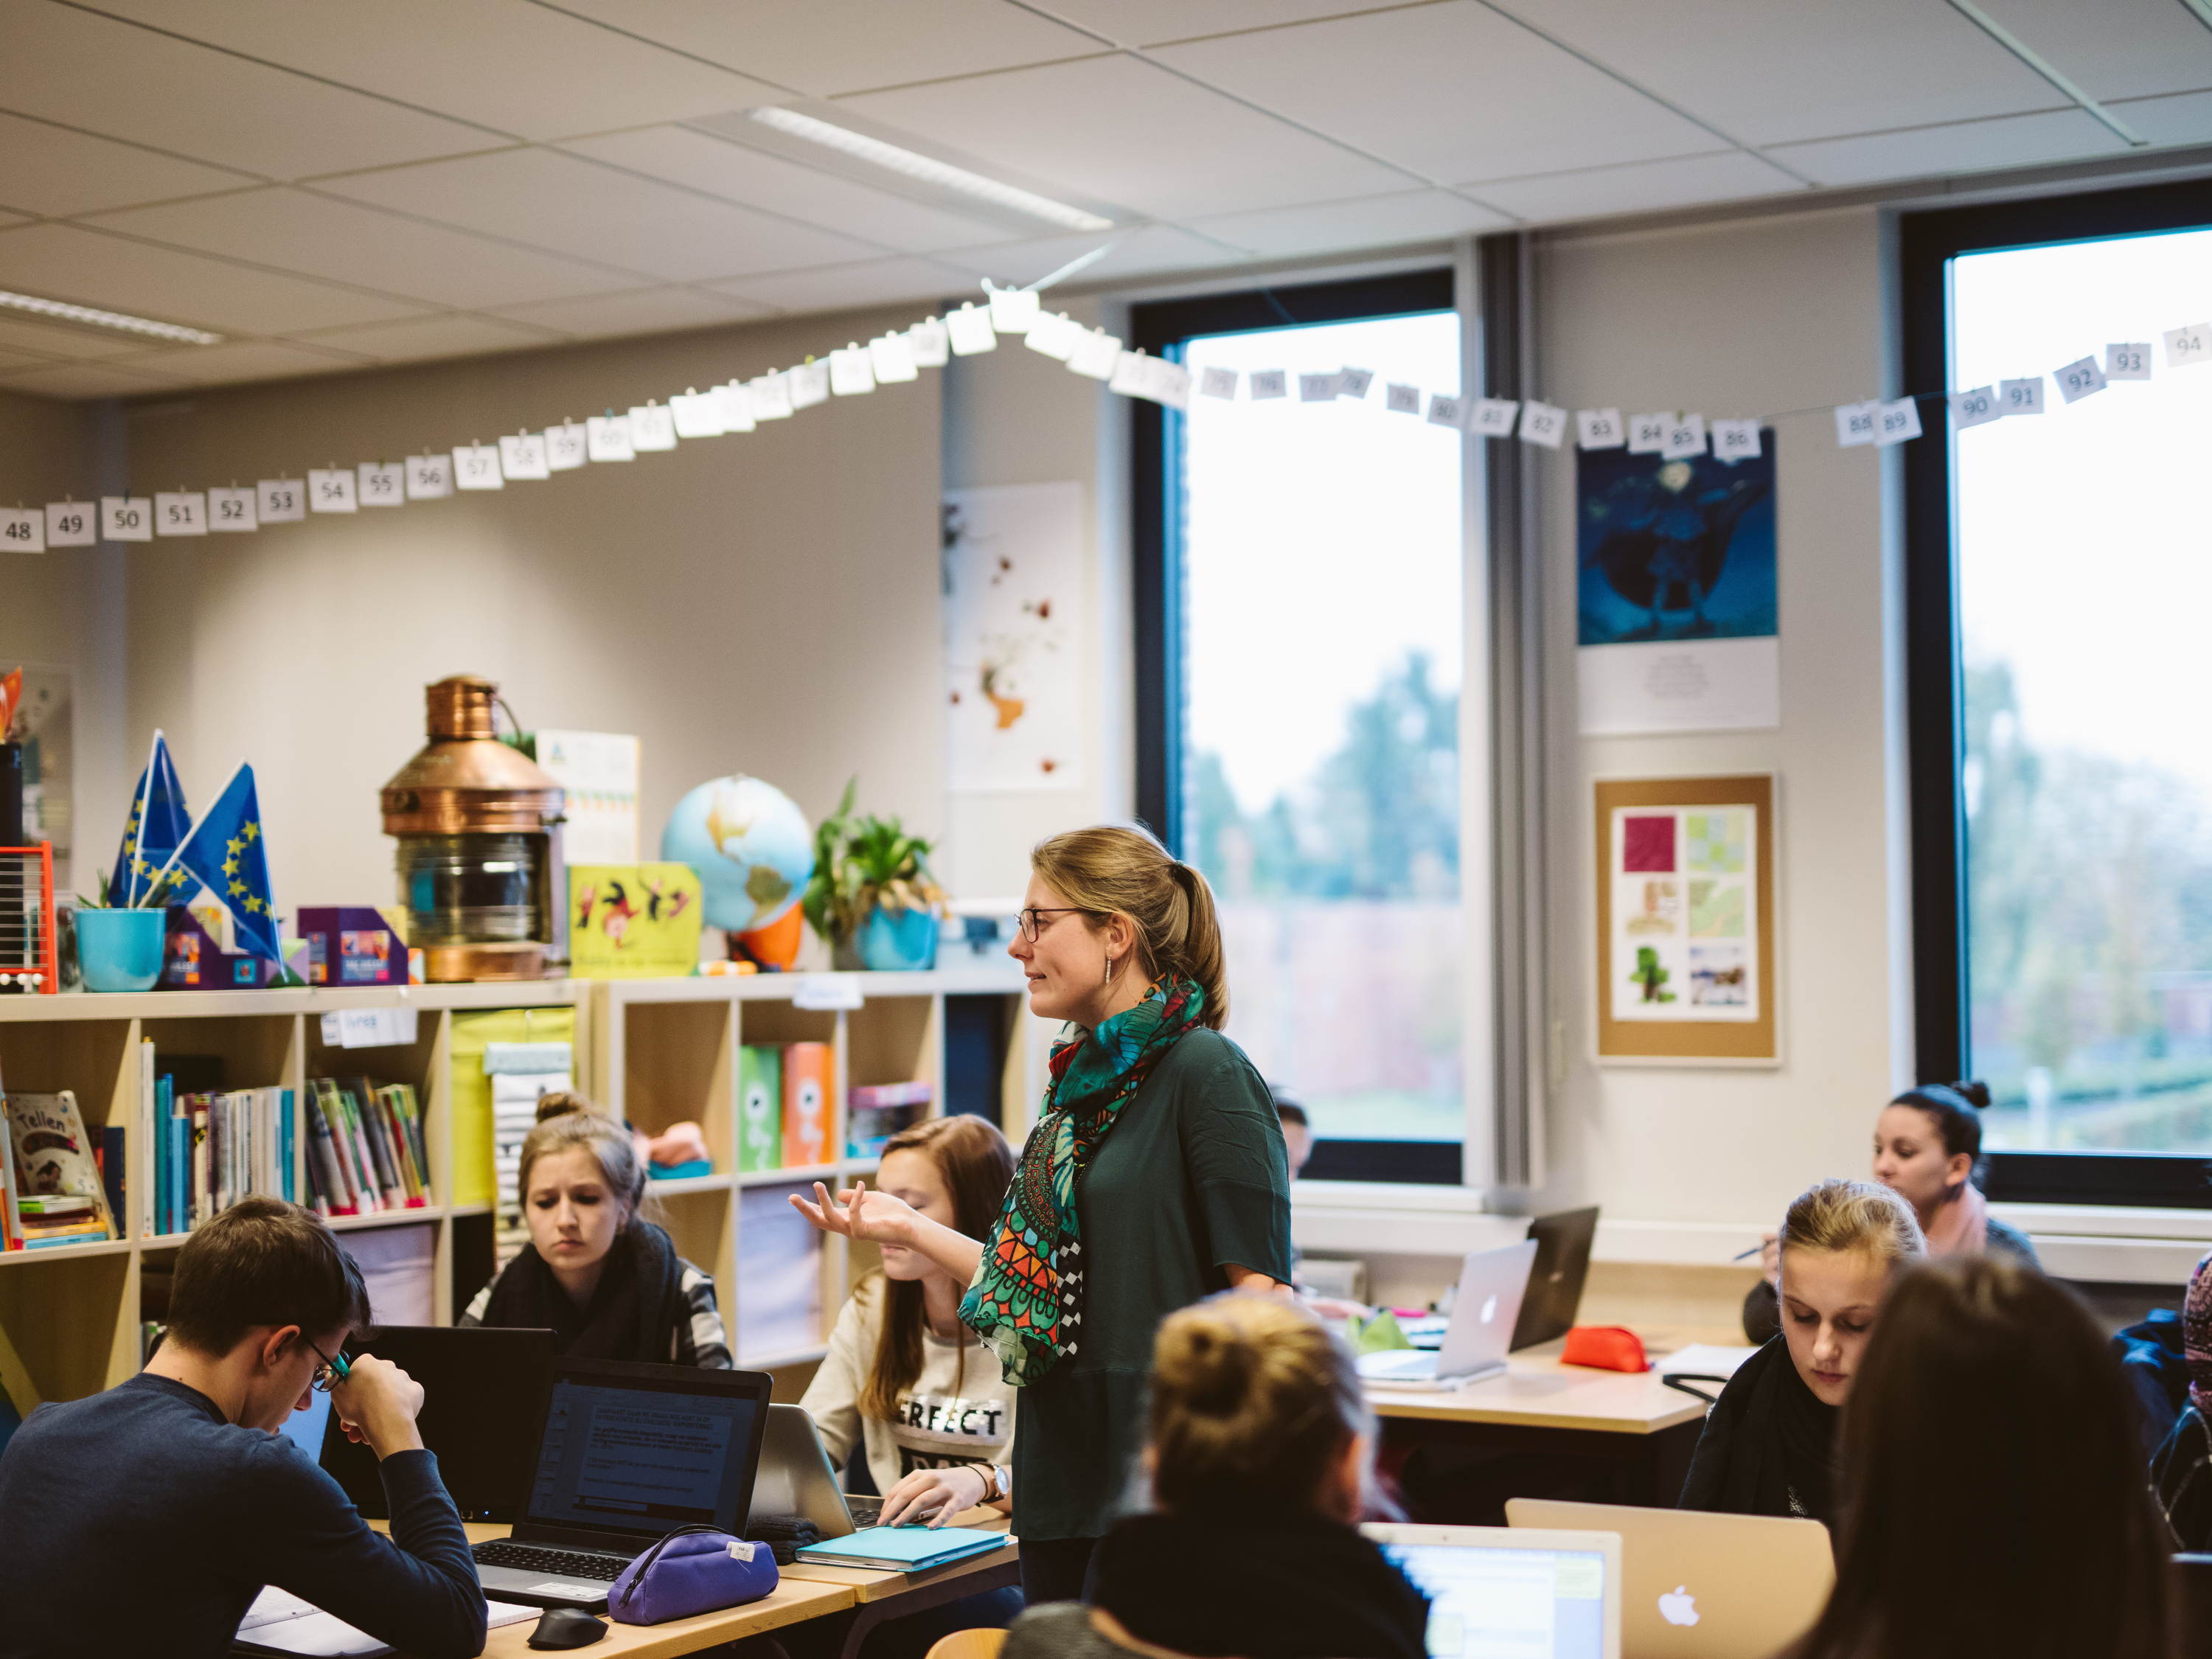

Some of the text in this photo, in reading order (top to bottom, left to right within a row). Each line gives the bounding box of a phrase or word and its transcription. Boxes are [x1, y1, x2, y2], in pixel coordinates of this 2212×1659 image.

[2177, 335, 2202, 357] 94
[2117, 352, 2141, 372] 93
[2068, 369, 2094, 392] 92
[2011, 388, 2034, 406] 91
[1964, 396, 1988, 418] 90
[1590, 419, 1613, 437] 83
[1849, 414, 1873, 433] 88
[1884, 411, 1907, 431] 89
[1641, 424, 1662, 441] 84
[1672, 426, 1694, 445] 85
[1725, 429, 1748, 446] 86
[418, 467, 441, 485] 56
[467, 459, 489, 478] 57
[321, 481, 344, 500] 54
[370, 475, 392, 494] 55
[221, 501, 244, 518] 52
[270, 492, 293, 510] 53
[114, 510, 139, 529] 50
[169, 505, 192, 524] 51
[6, 522, 30, 540] 48
[59, 515, 83, 534] 49
[16, 1109, 66, 1133] Tellen
